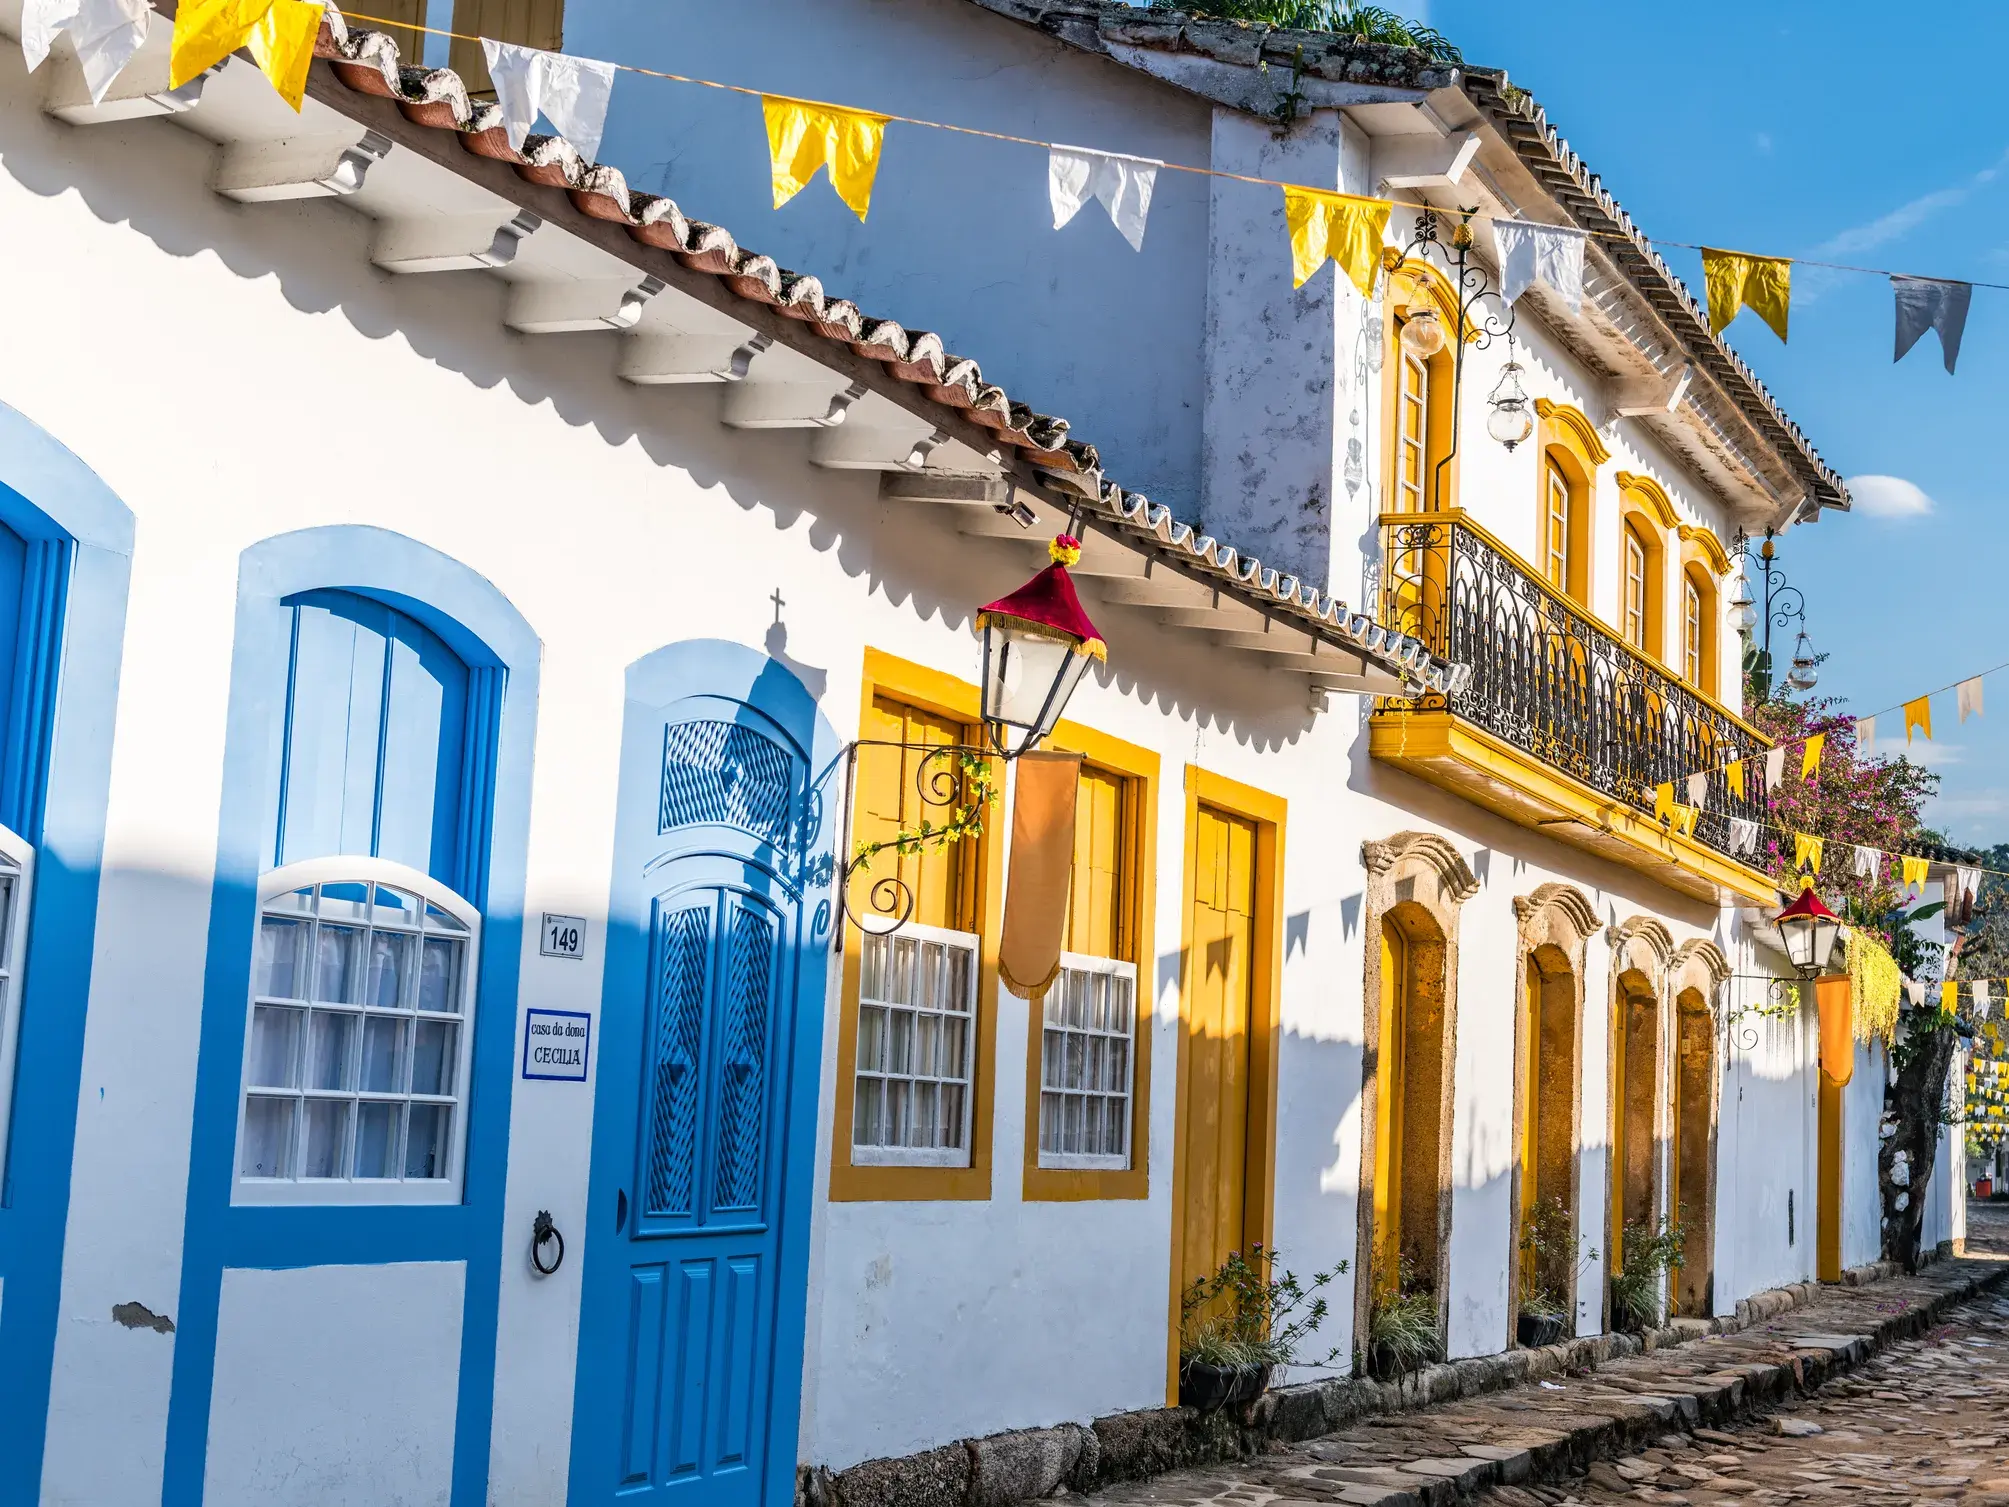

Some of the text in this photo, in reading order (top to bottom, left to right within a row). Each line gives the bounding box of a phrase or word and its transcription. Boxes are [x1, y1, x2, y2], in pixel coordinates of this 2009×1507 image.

[550, 926, 578, 952] 149
[531, 1021, 586, 1038] casa da dona
[534, 1046, 581, 1066] CECILIA
